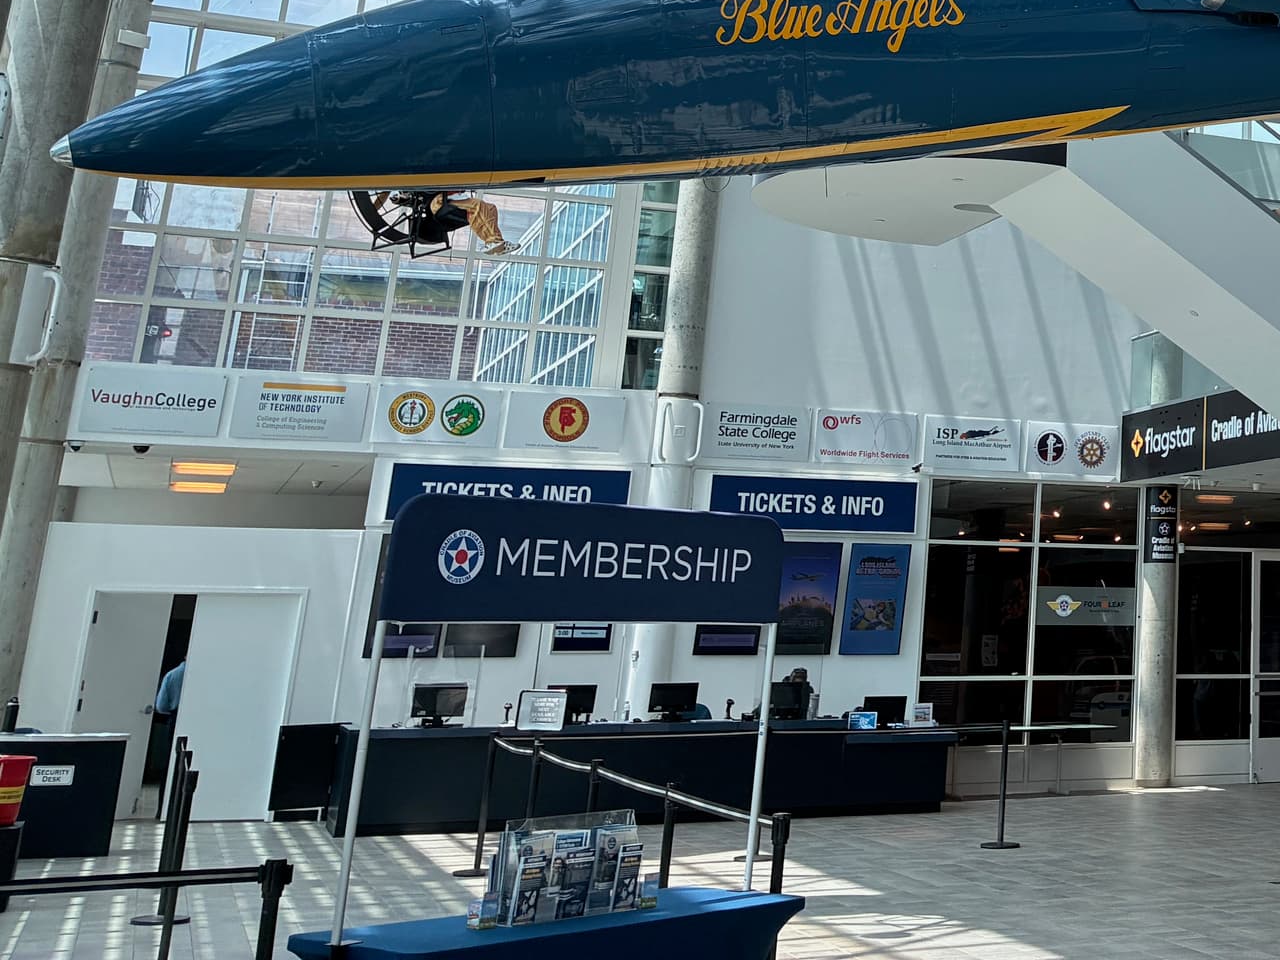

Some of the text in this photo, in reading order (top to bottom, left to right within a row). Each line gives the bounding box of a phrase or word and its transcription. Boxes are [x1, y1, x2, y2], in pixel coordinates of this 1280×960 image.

[91, 388, 217, 412] VaughnCollege
[260, 392, 345, 405] NEW YORK INSTITUTE
[258, 402, 322, 413] OF TECHNOLOGY
[719, 411, 798, 427] Farmingdale
[840, 414, 862, 425] wfs
[718, 425, 797, 442] State College
[936, 427, 959, 440] ISP
[1145, 425, 1196, 458] flagstar
[1211, 415, 1242, 442] Cradle
[1245, 411, 1255, 436] of
[732, 441, 760, 449] University
[932, 439, 946, 447] Long
[992, 442, 1012, 450] Airport
[820, 448, 910, 459] Worldwide Flight Services
[421, 481, 593, 503] TICKETS & INFO
[737, 492, 885, 516] TICKETS & INFO
[1150, 504, 1177, 515] flagsta
[495, 537, 752, 583] MEMBERSHIP
[36, 768, 70, 776] SECURITY
[42, 775, 62, 783] DESK
